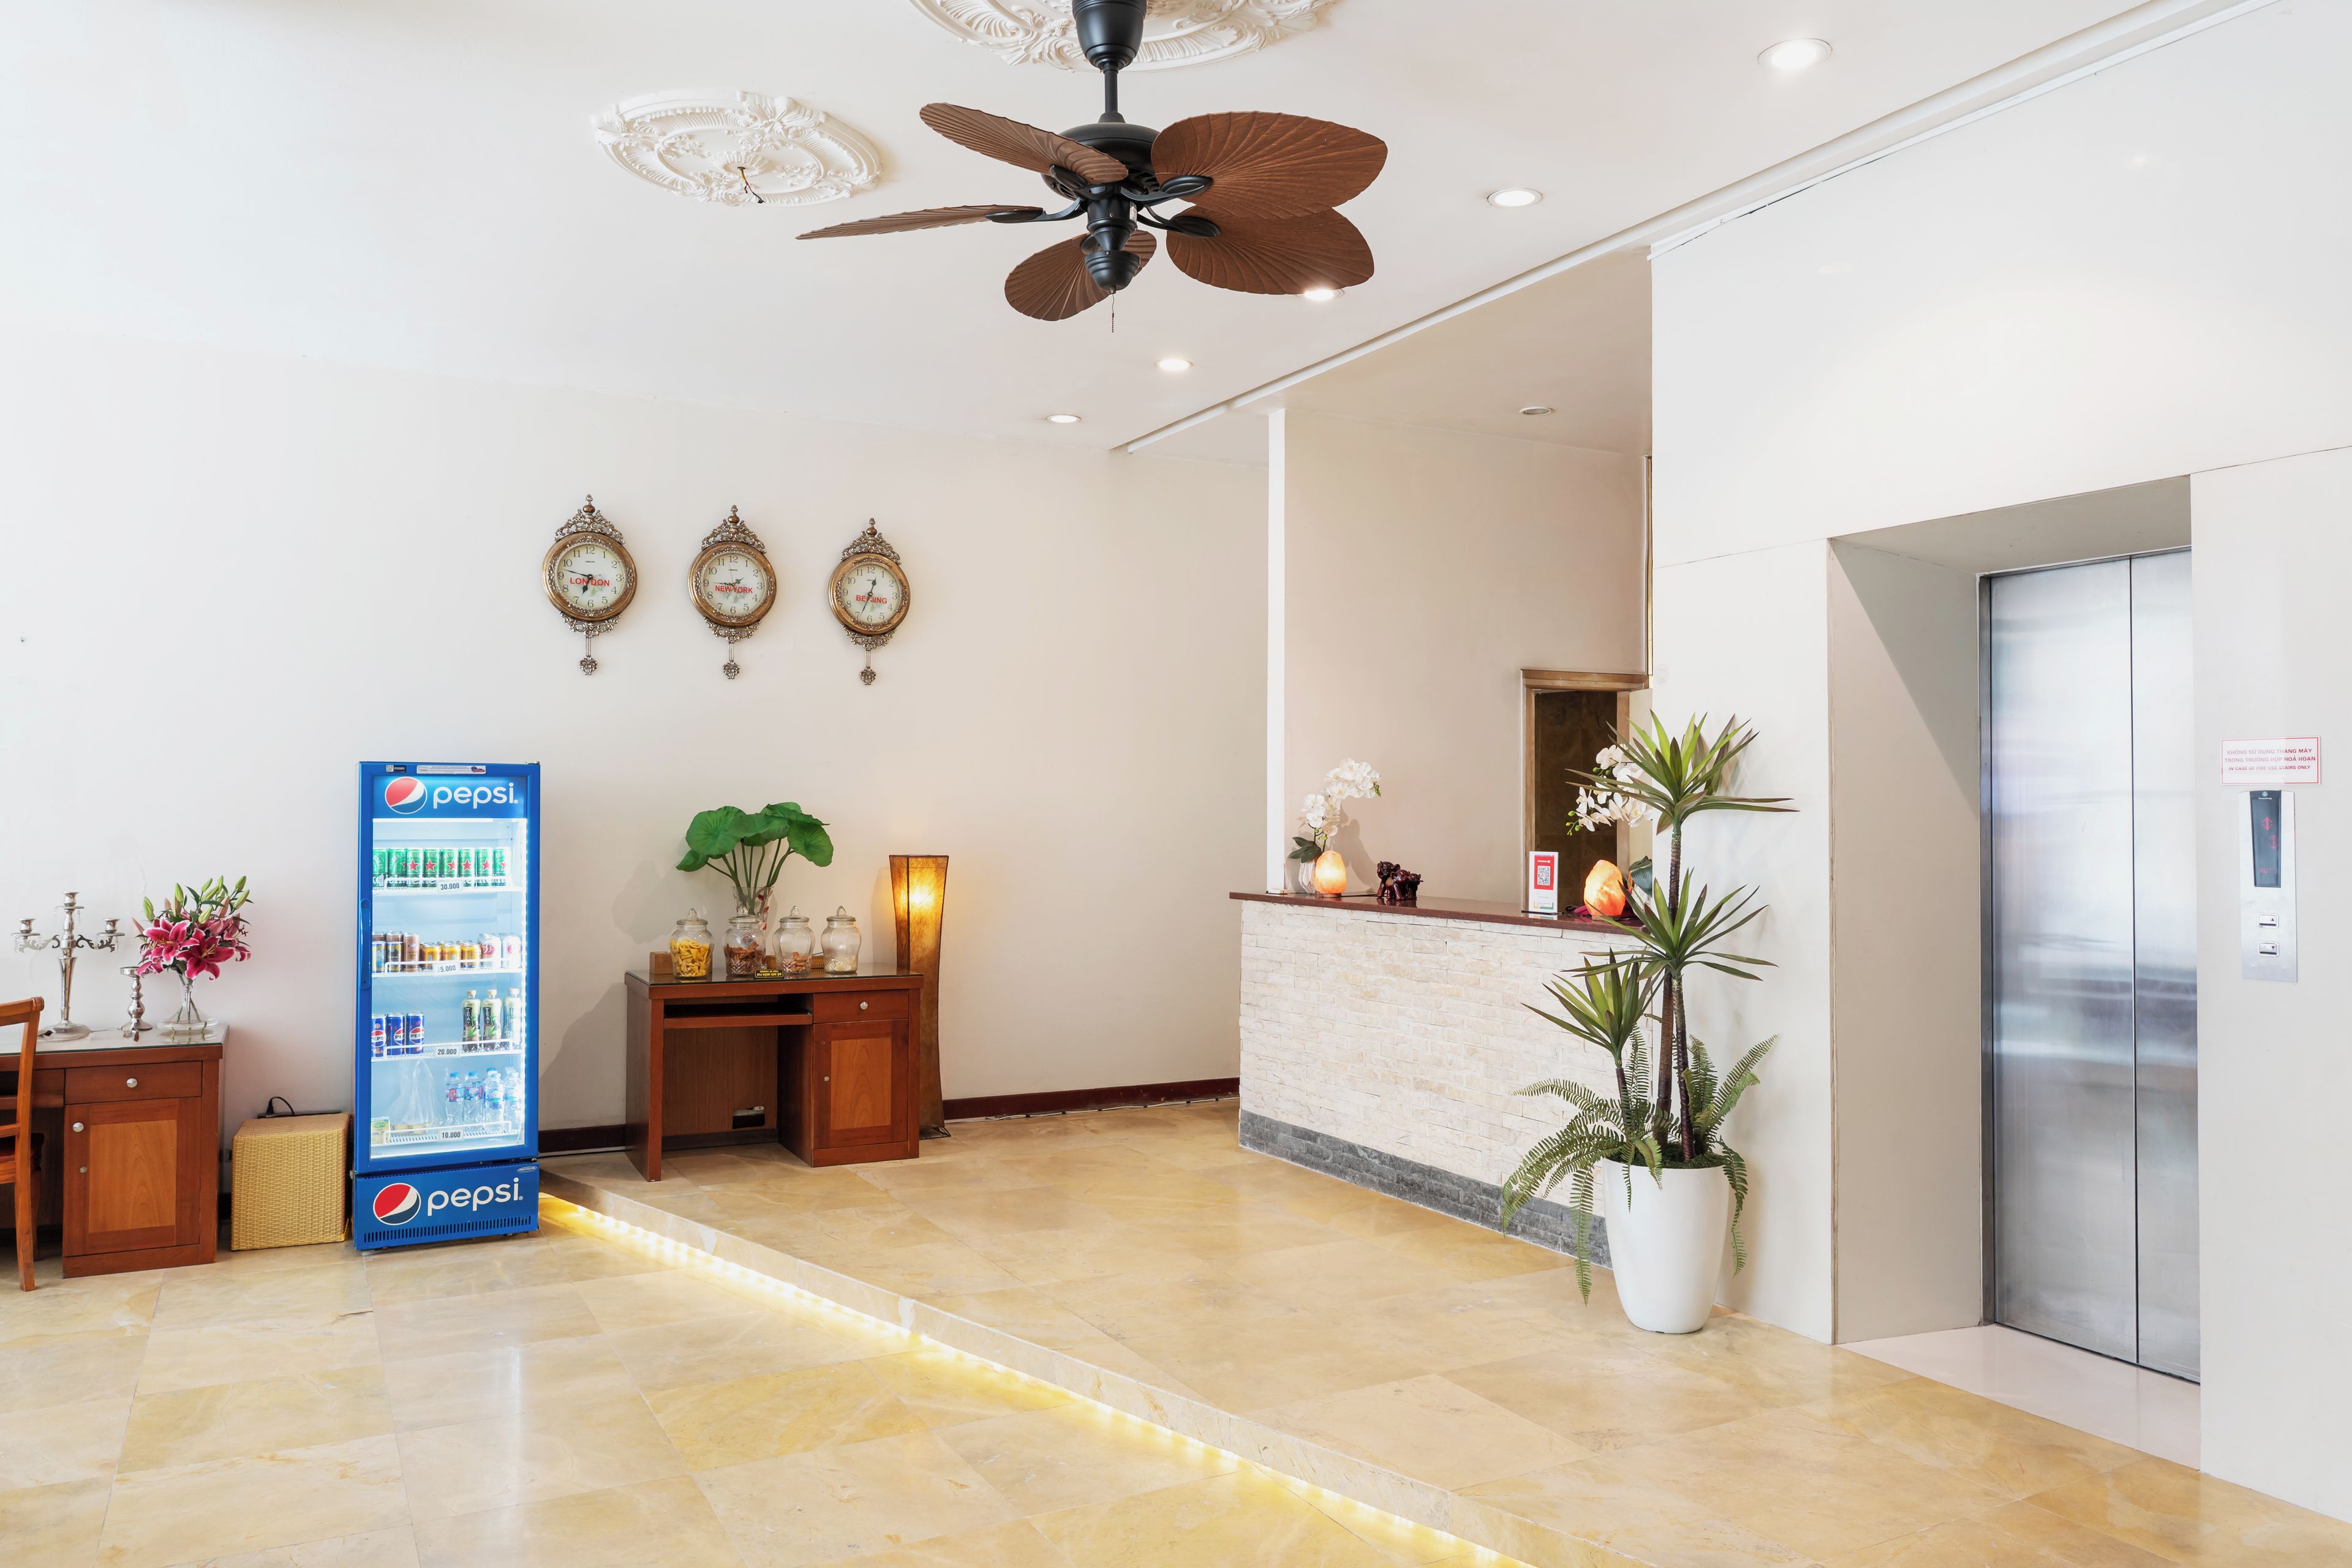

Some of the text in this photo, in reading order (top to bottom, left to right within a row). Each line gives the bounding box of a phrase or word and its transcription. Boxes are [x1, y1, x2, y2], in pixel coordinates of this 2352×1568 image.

[570, 578, 610, 586] LONDON
[562, 584, 569, 593] 8
[856, 595, 888, 604] BEIJING
[433, 782, 514, 809] pepsi
[428, 1177, 519, 1216] pepsi
